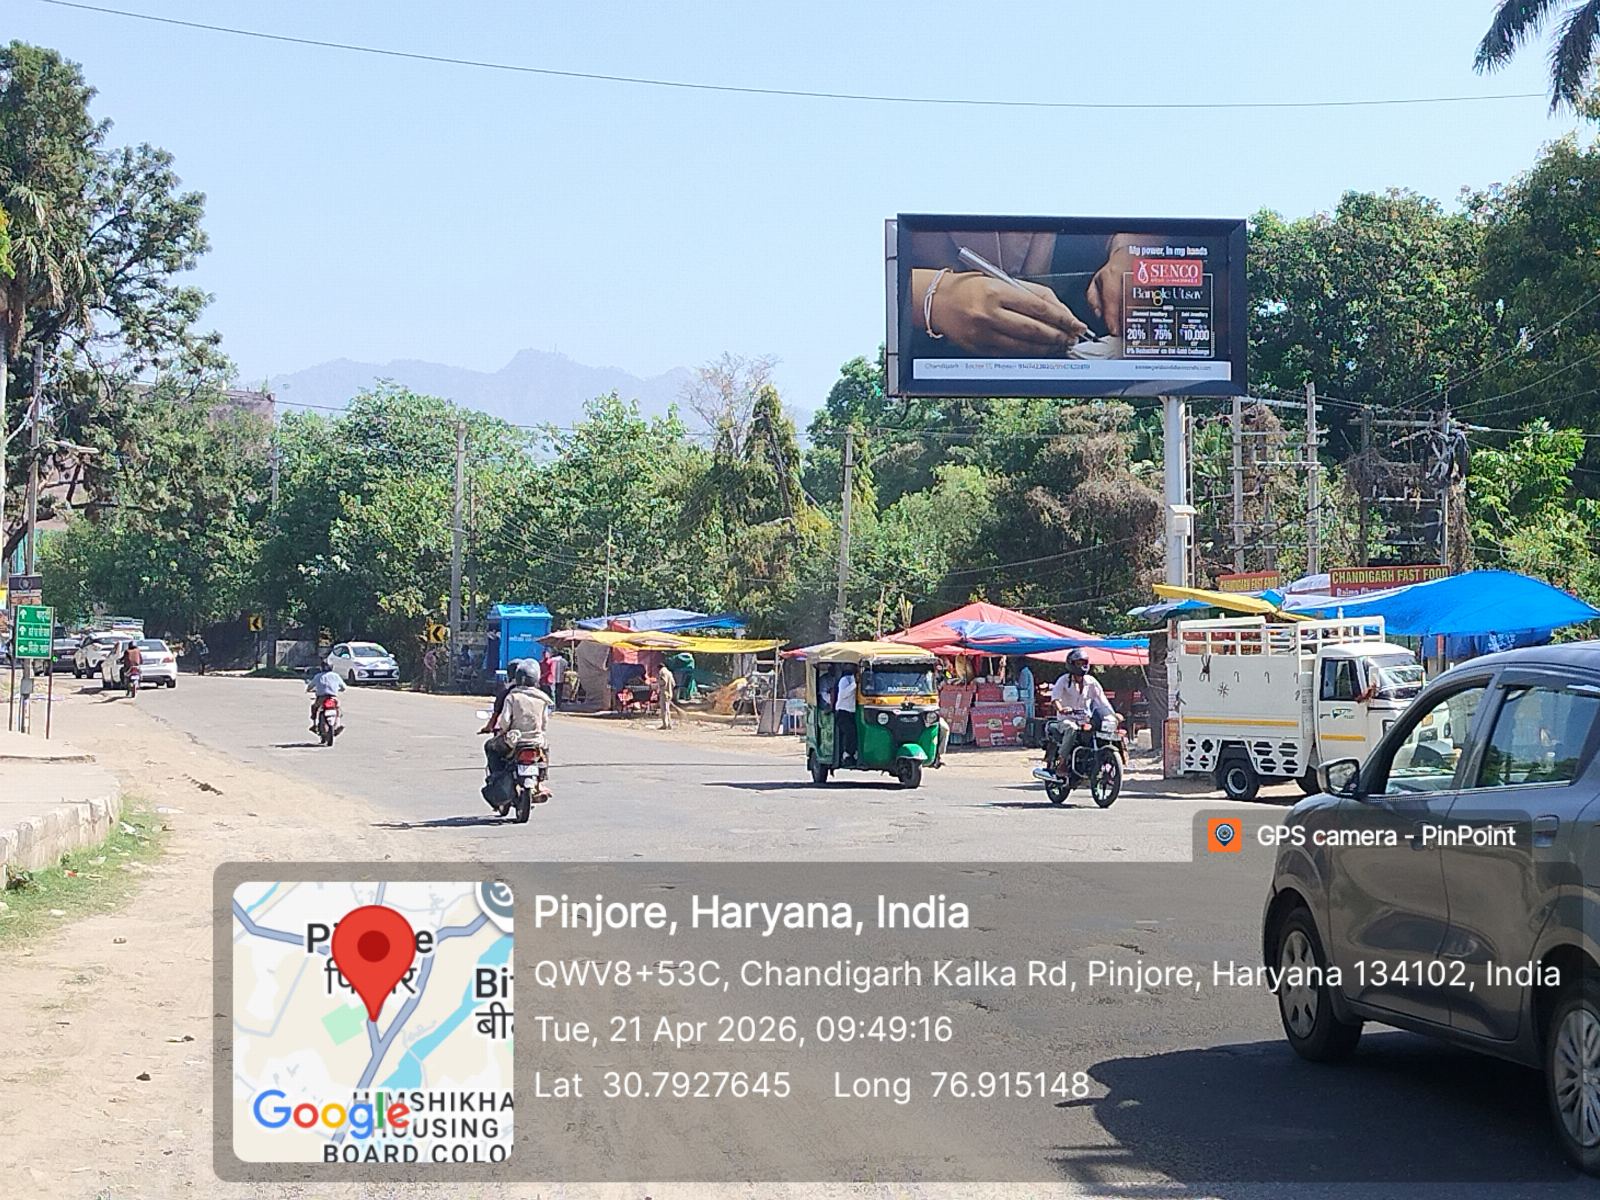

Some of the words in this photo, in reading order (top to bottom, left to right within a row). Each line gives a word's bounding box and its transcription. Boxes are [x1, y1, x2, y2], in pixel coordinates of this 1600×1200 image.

[1142, 247, 1165, 257] power,
[1174, 248, 1186, 257] my
[1187, 246, 1208, 256] hands
[1150, 264, 1199, 278] SENCO
[1173, 287, 1203, 299] Utsav
[1127, 328, 1146, 340] 20%
[1153, 329, 1173, 340] 75%
[1332, 569, 1394, 584] CHANDIGARH
[1397, 568, 1421, 582] FAST
[1423, 567, 1448, 580] FOOD
